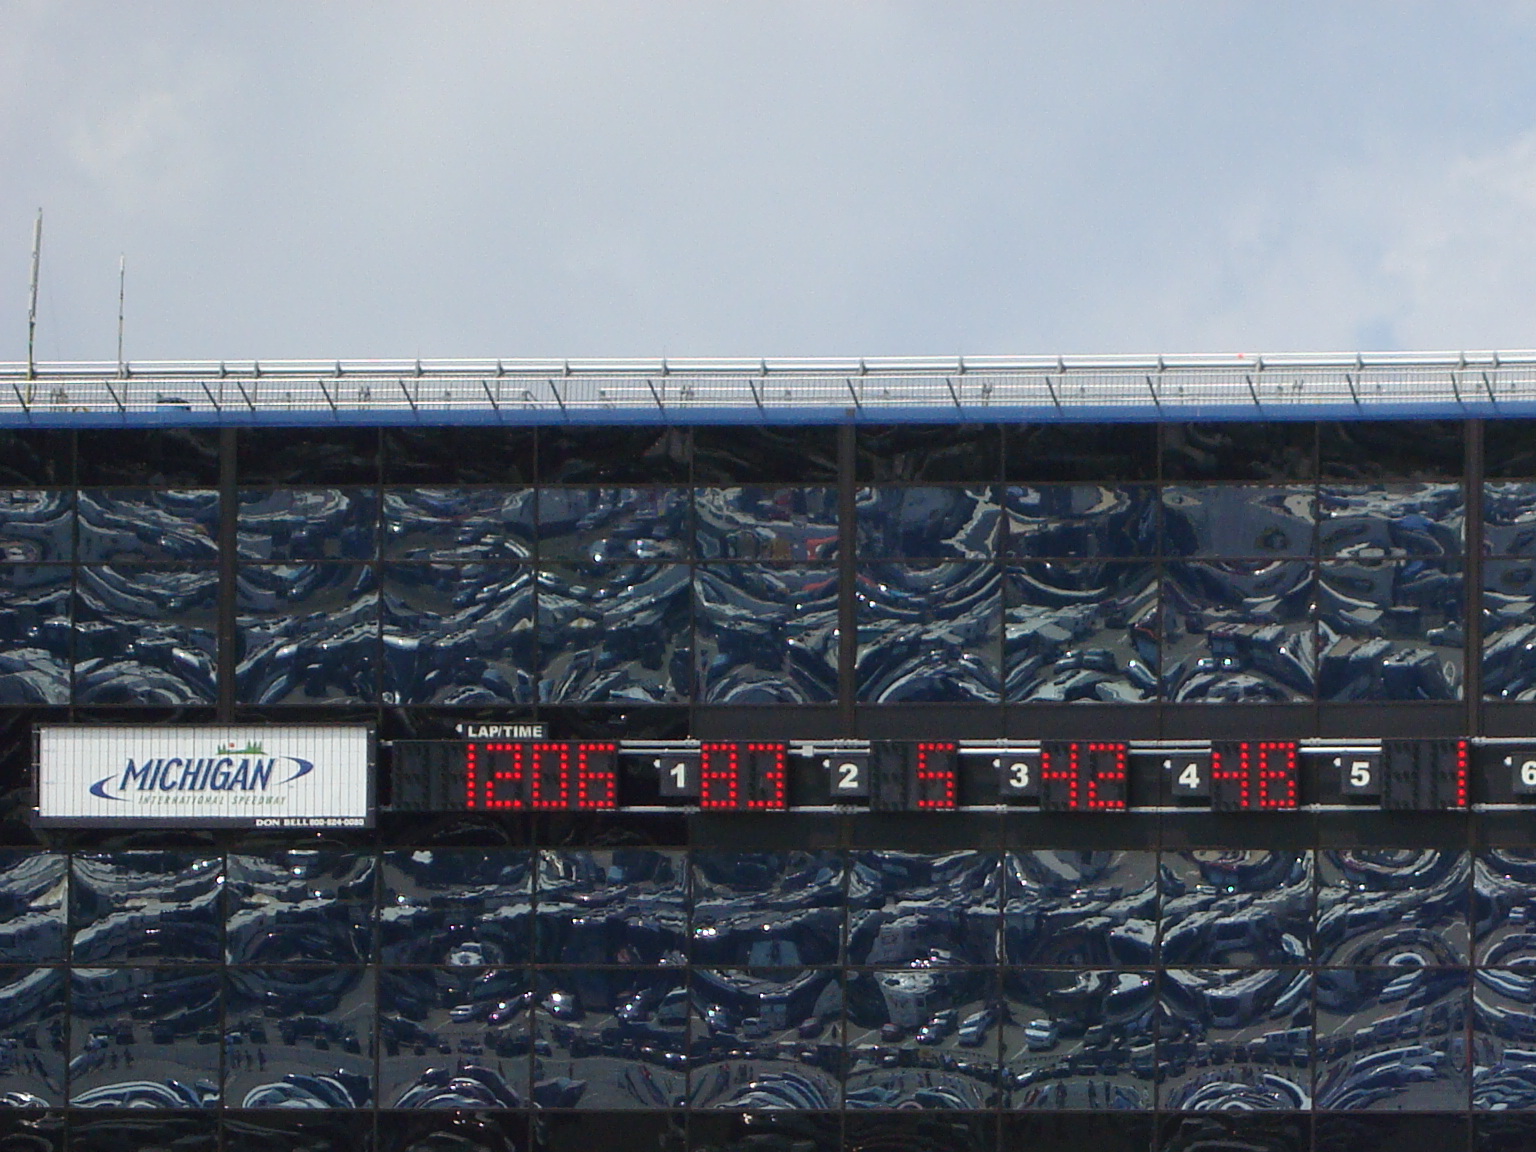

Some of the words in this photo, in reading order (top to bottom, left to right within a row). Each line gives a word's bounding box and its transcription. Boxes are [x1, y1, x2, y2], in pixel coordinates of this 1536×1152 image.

[467, 724, 543, 738] LAP/TIME
[118, 756, 278, 792] MICHIGAN
[467, 743, 616, 808] 1206
[669, 763, 686, 788] 1
[838, 763, 859, 789] 2
[917, 743, 954, 808] 5
[1009, 763, 1029, 789] 3
[1041, 743, 1125, 808] 42
[1178, 763, 1200, 789] 4
[1211, 742, 1296, 808] 48
[1350, 761, 1371, 787] 5
[1457, 740, 1467, 807] 1
[138, 795, 225, 805] INTERNATIONAL
[231, 795, 287, 805] SPEEDWAY
[255, 818, 280, 827] DON
[284, 818, 309, 827] BELL
